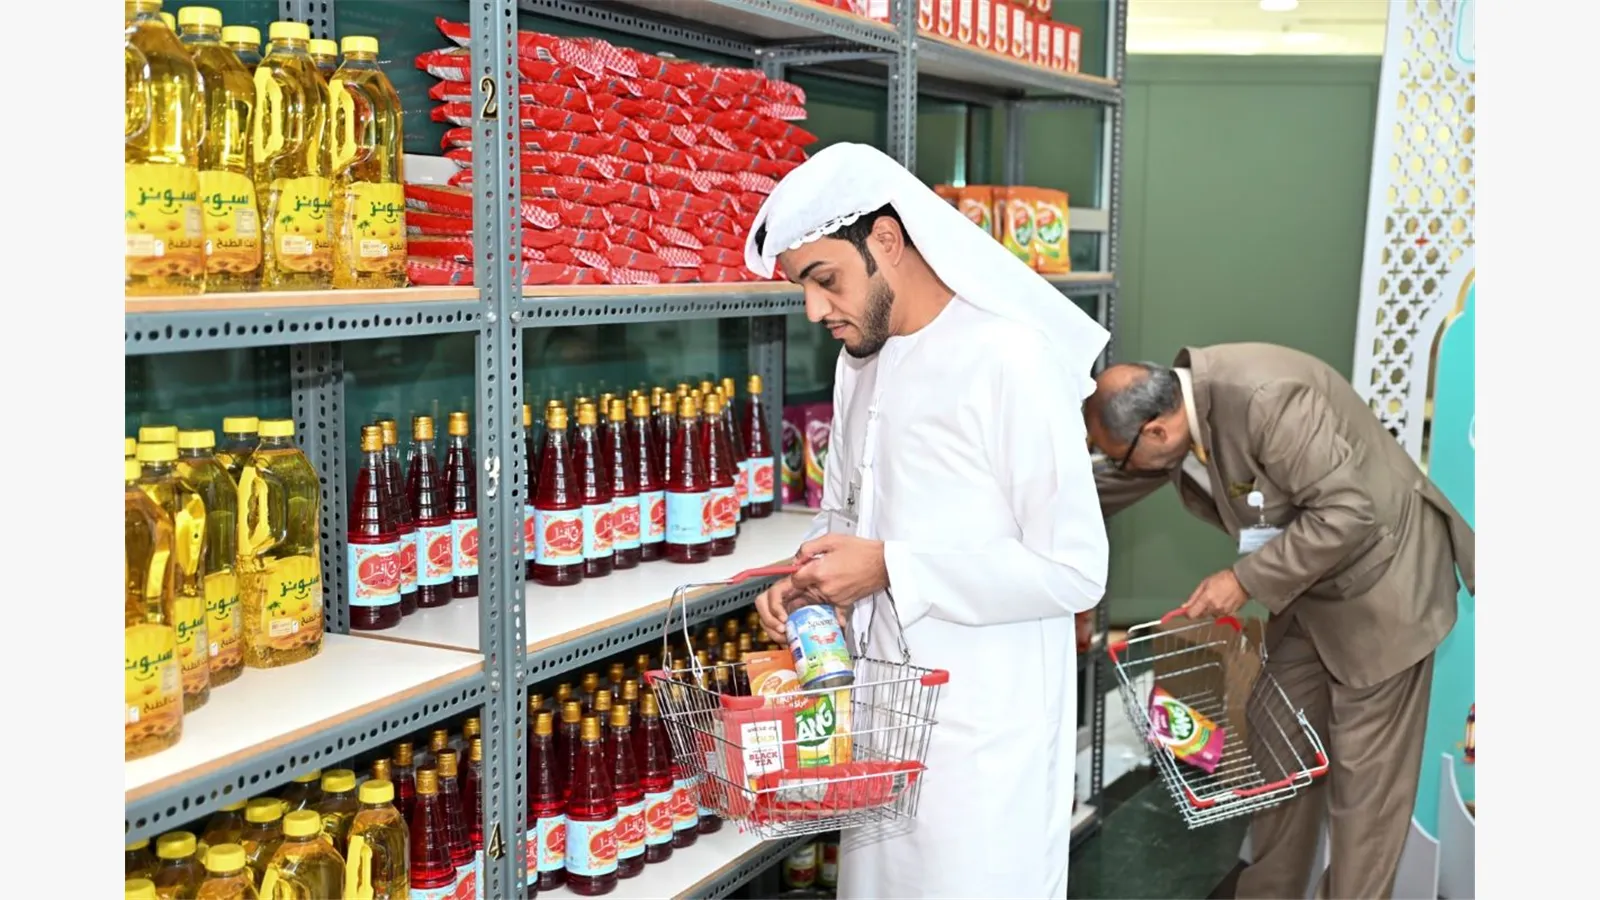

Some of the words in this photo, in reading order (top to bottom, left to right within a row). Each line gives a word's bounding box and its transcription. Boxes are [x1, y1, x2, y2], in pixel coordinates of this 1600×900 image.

[480, 75, 497, 118] 2
[206, 594, 239, 614] سبون
[125, 650, 172, 674] سبون
[749, 751, 778, 761] BLACK
[755, 758, 773, 767] TEA
[486, 820, 505, 860] 4
